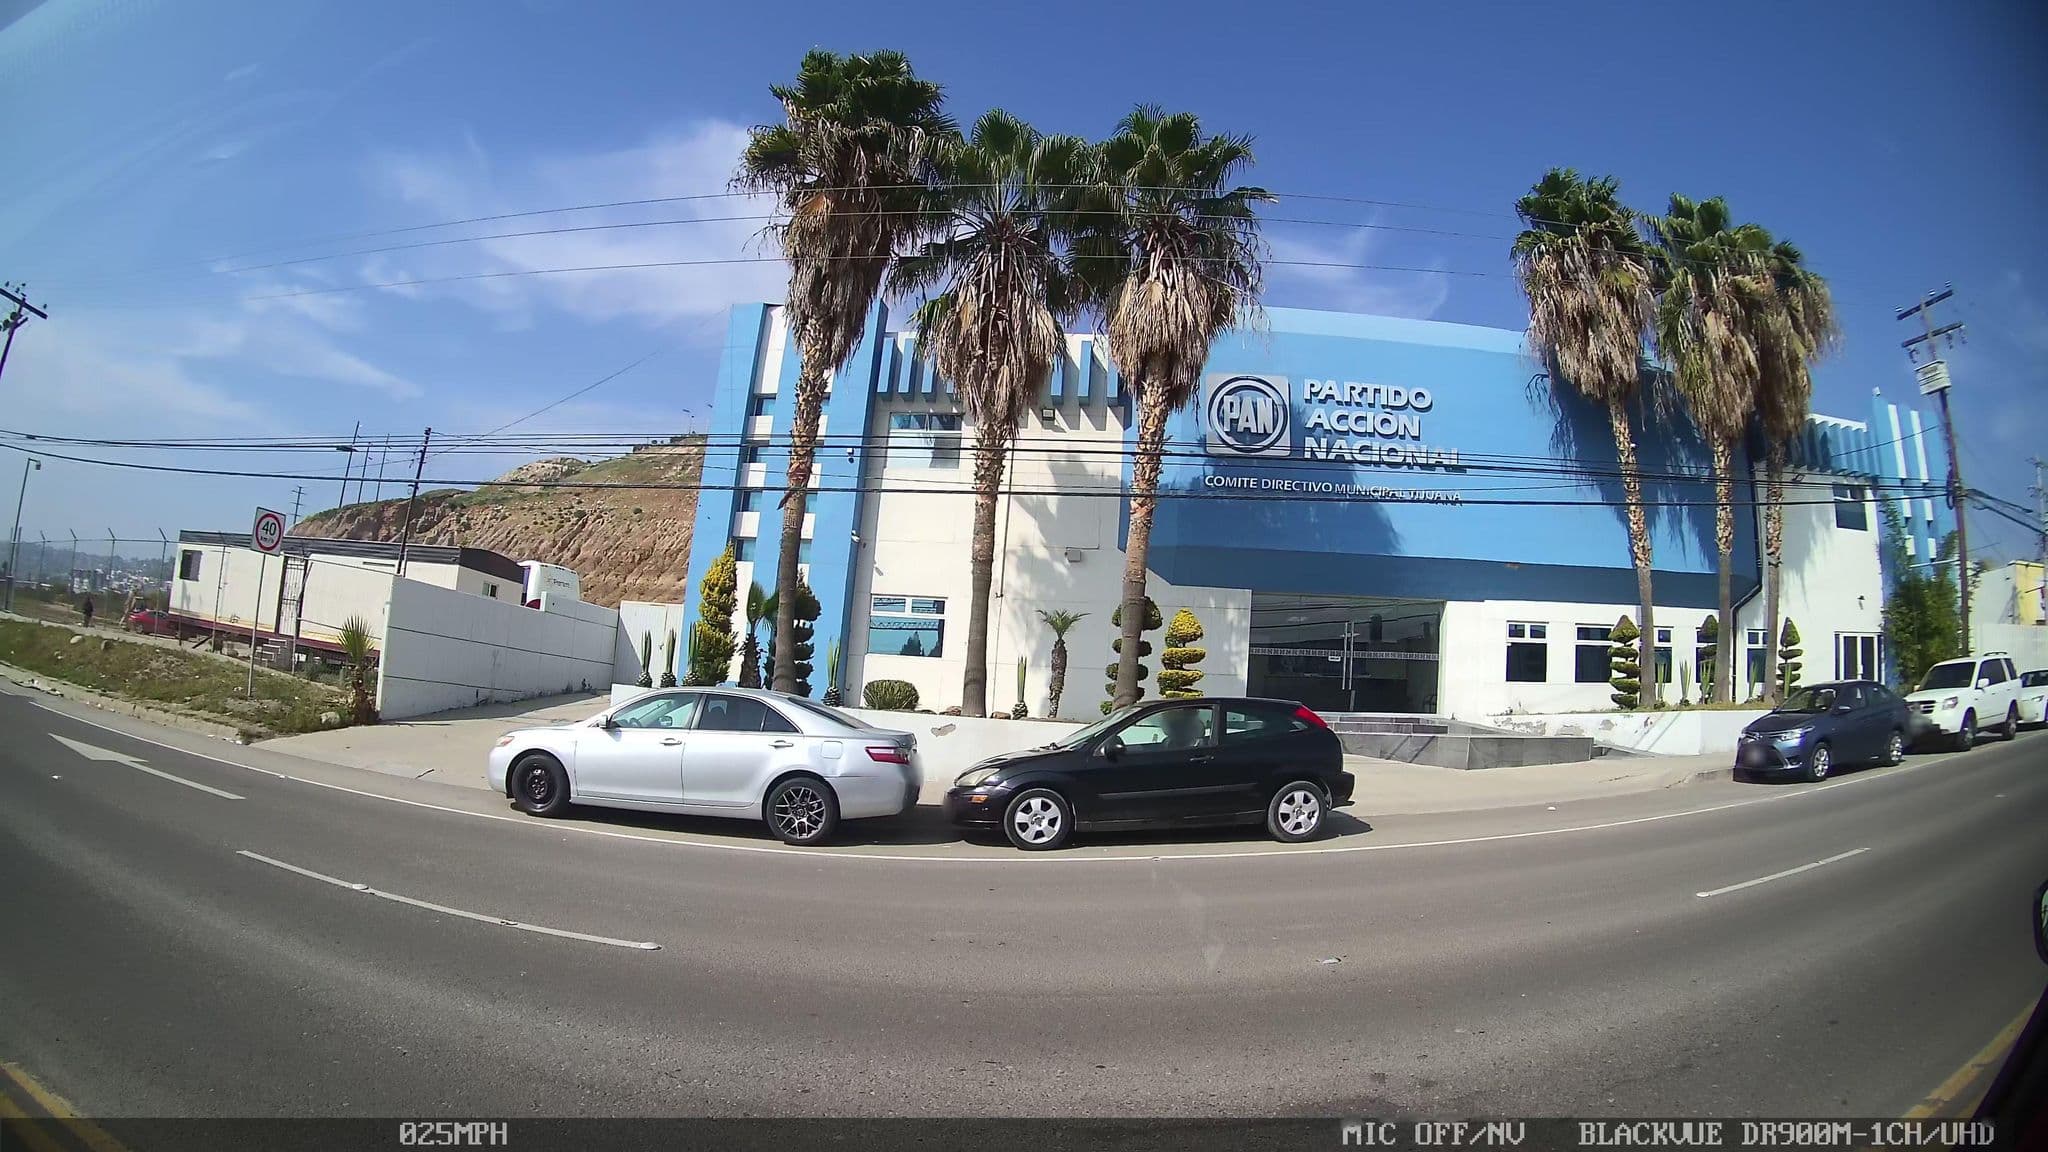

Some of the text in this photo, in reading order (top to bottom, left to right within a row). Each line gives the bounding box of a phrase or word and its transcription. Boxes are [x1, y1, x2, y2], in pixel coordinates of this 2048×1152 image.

[1303, 378, 1432, 410] PARTIDO
[1223, 394, 1274, 434] PAN
[1303, 436, 1462, 468] NACIONAL
[1204, 475, 1462, 501] COMITE DIRECTIVO MUNICIPAL TIJUANA
[261, 520, 277, 537] 40
